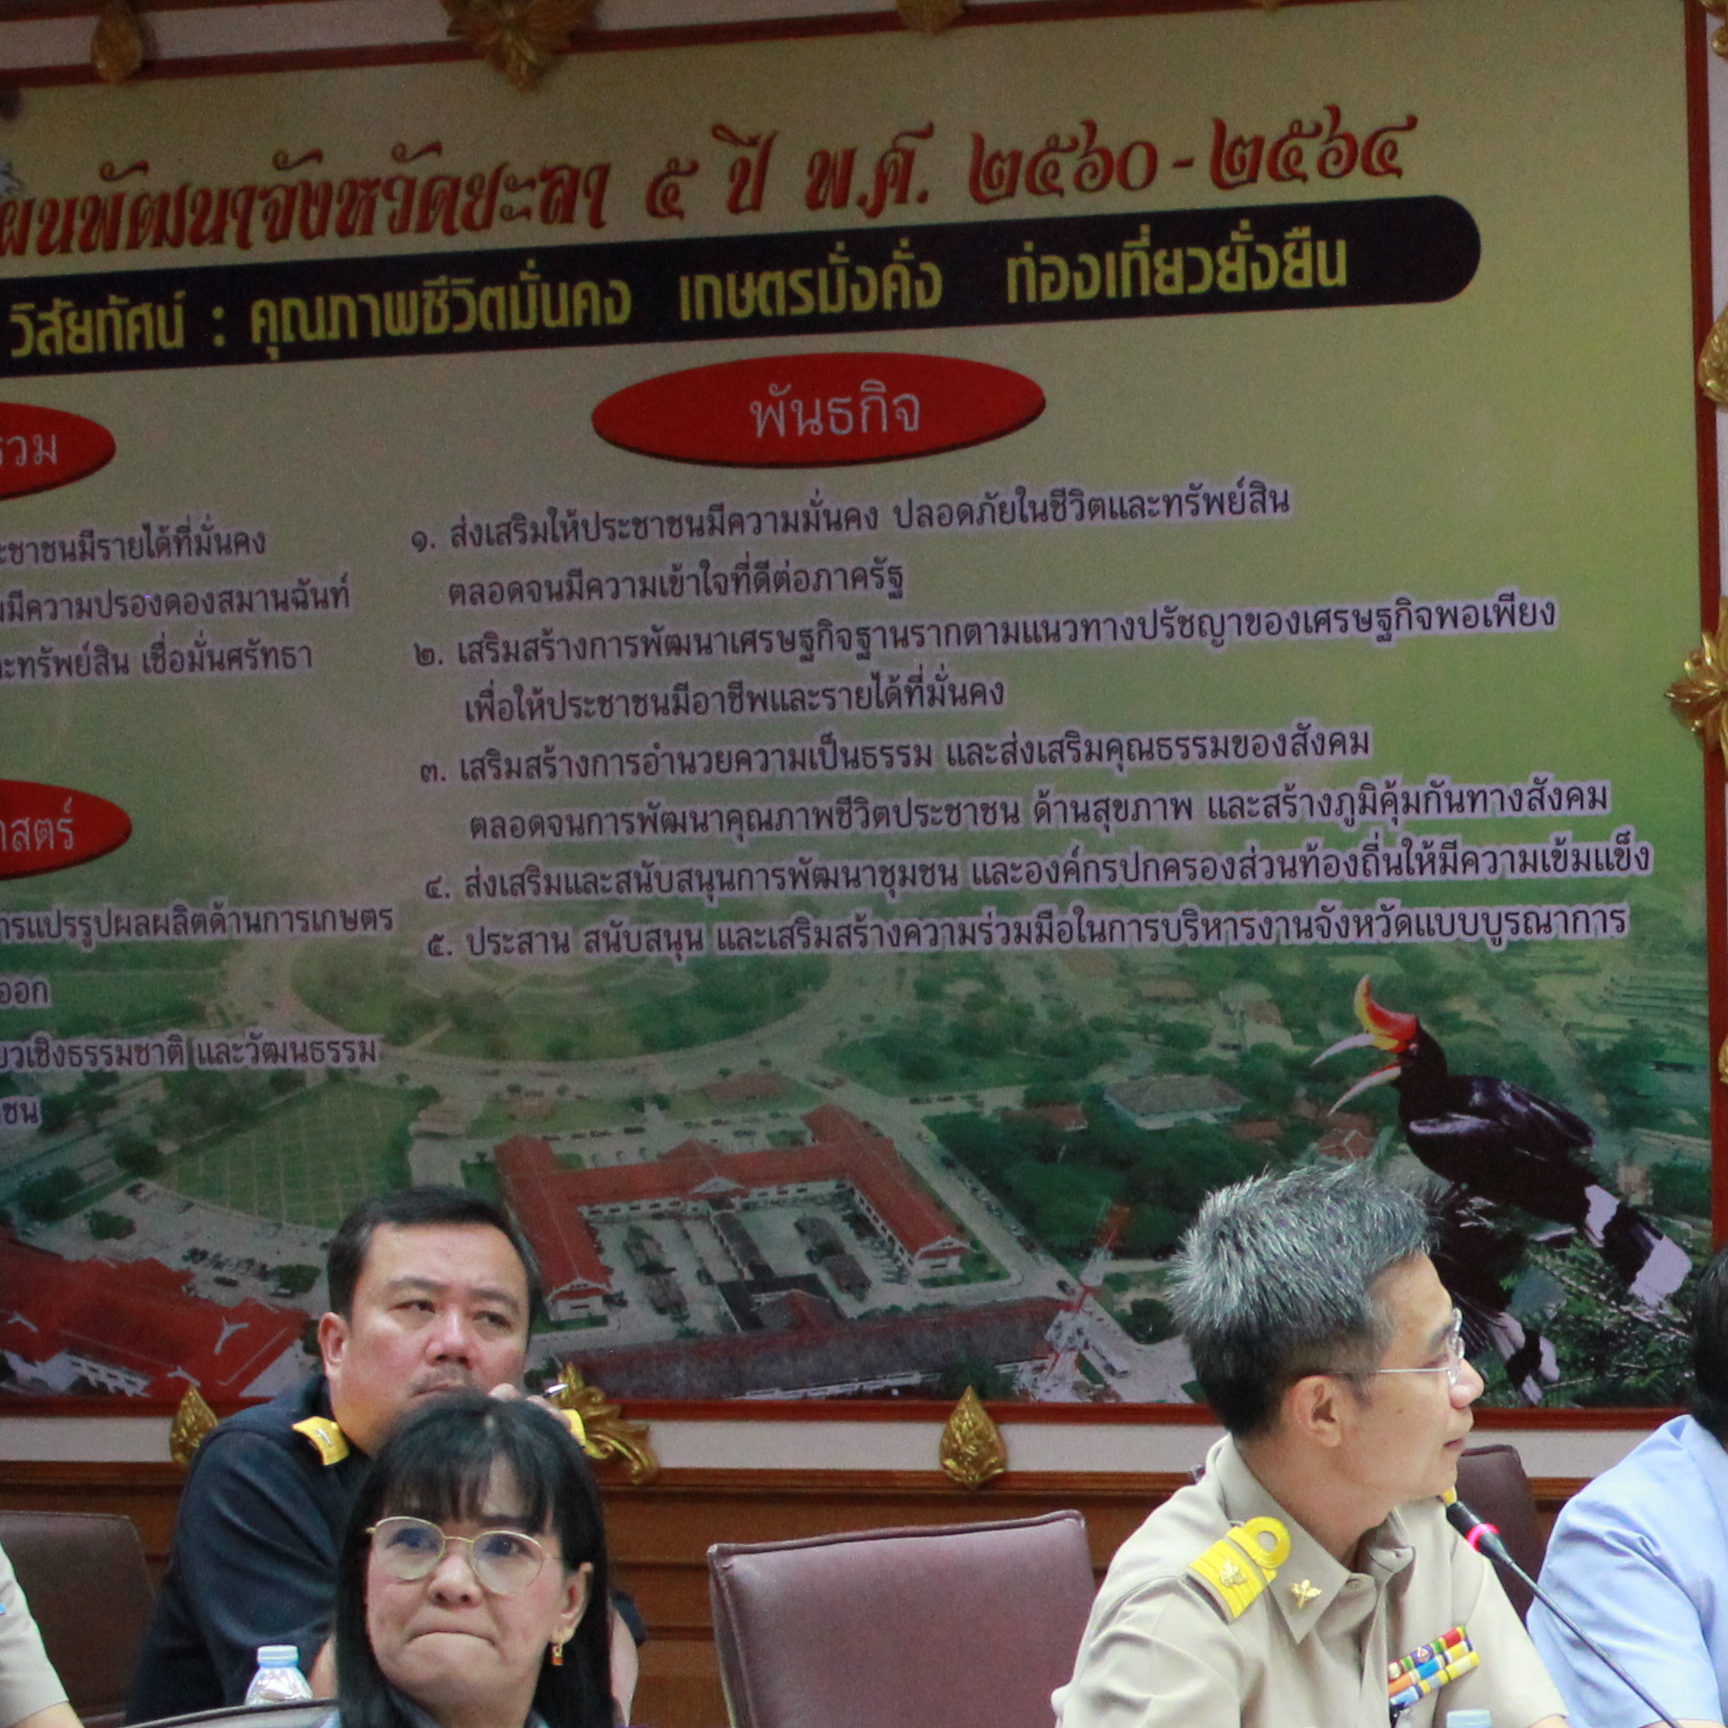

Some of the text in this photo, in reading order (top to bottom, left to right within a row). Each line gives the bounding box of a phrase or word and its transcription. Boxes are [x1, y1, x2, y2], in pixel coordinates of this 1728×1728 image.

[645, 157, 701, 220] ๕
[710, 122, 779, 214] ปี
[805, 122, 935, 218] พ.ศ.
[10, 291, 186, 358] วิสัยทัศน์
[251, 259, 632, 363] คุณภาพชีวิตมั่นคง
[680, 239, 944, 323] เกษตรมั่งคั่ง
[1006, 219, 1348, 306] ท่องเที่ยวยั่งยืน
[748, 377, 922, 439] พันธกิจ
[449, 488, 878, 550] ส่งเสริมให้ประชาชนมีความมั่นคง
[893, 476, 1290, 531] ปลอดภัยในชีวิตและทรัพย์สิน
[447, 551, 905, 608] ตลอดจนมีความเข้าใจที่ดีต่อภาครัฐ
[142, 630, 314, 675] เชื่อมั่นศรัทธา
[464, 664, 1006, 724] เพื่อให้ประชาชนมีอาชีพและรายได้ที่มั่นคง
[459, 731, 934, 784] เสริมสร้างการอำนวยความเป็นธรรม
[945, 723, 1371, 774] และส่งเสริมคุณธรรมของสังคม
[469, 775, 1609, 845] ตลอดจนการพัฒนาคุณภาพชีวิตประชาชน ด้านสุขภาพ และสร้างภูมิคุ้มกันทางสังคม
[464, 858, 959, 906] ส่งเสริมและสนับสนุนการพัฒนาชุมชน
[971, 828, 1652, 887] และองค์กรปกครองส่วนท้องถิ่นให้มีความเข้มแข็ง
[465, 925, 570, 956] ประสาน
[583, 917, 705, 962] สนับสนุน
[716, 904, 1627, 953] และเสริมสร้างความร่วมมือในการบริหารงานจังหวัดแบบบูรณาการ
[196, 1034, 377, 1066] และวัฒนธรรม
